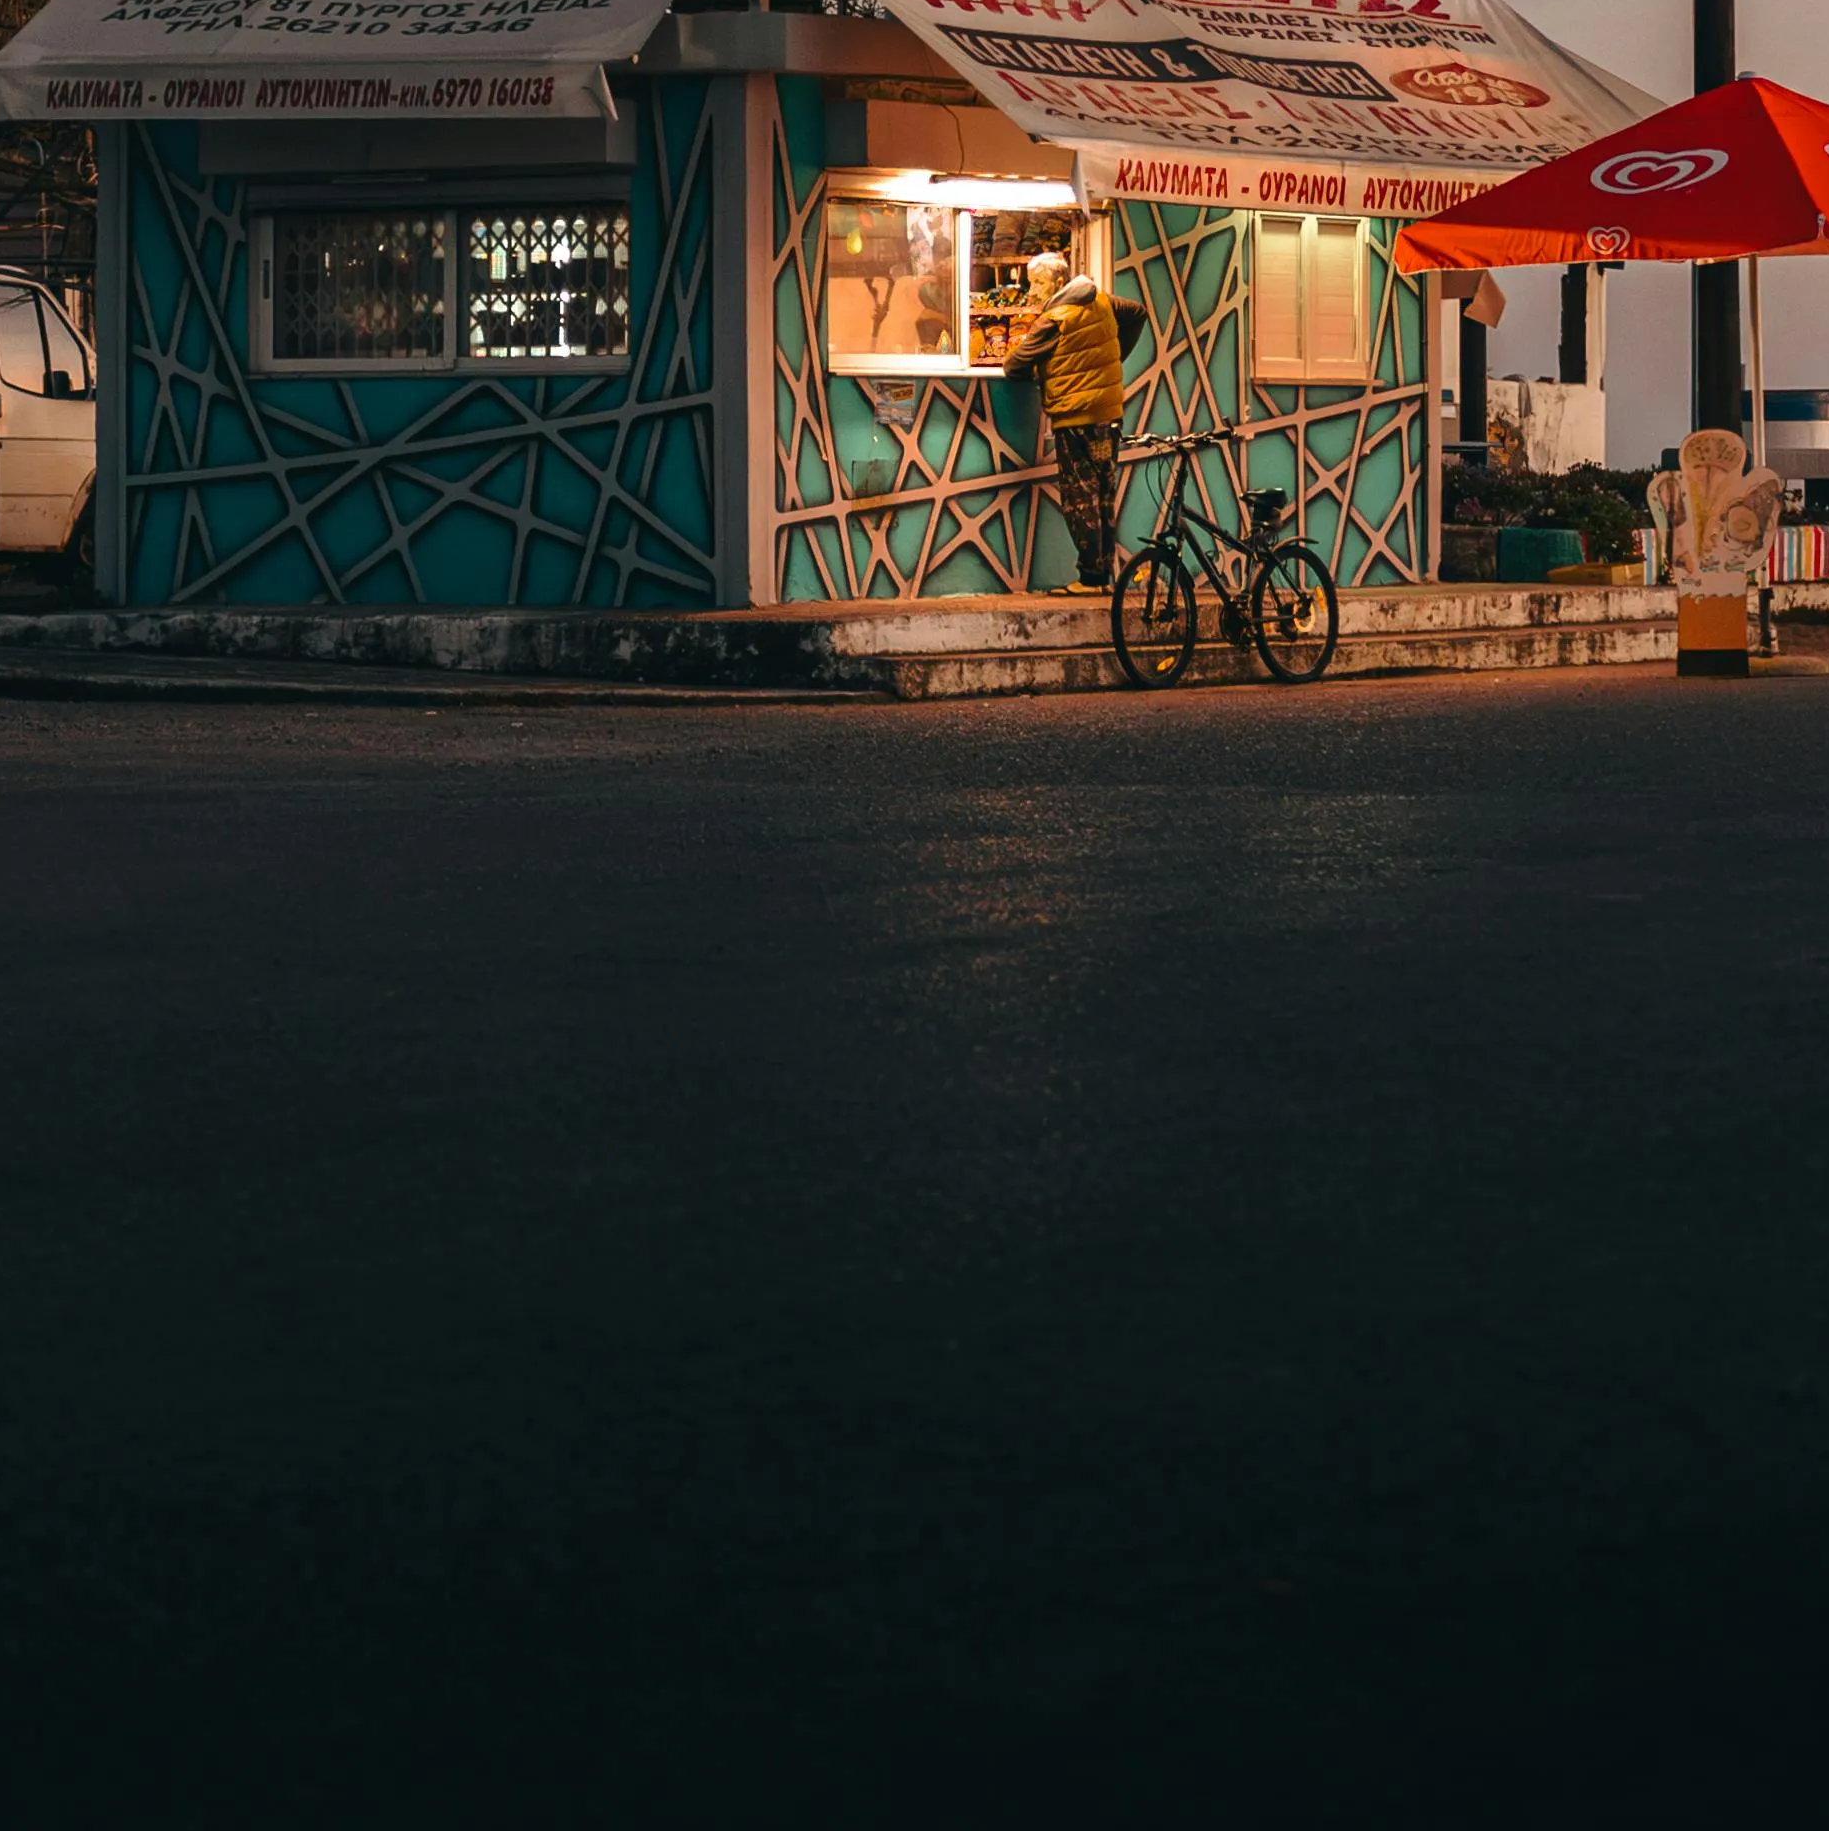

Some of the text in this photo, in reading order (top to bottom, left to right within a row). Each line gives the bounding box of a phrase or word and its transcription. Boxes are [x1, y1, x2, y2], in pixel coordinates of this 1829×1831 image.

[321, 1, 475, 18] ΠΥΡΓΟΣ
[401, 18, 535, 35] 34346
[1199, 22, 1342, 45] ΠΕΡΣΙΔΕΣ
[948, 32, 1382, 98] ΚΑΤΑΣΚΕΥΗ & ΤΟΠΟΘΕΤΗΣΗ
[47, 80, 143, 109] ΚΑΛΥΜΑΤΑ
[164, 79, 245, 108] ΟΥΡΑΝΟΙ
[1482, 143, 1572, 156] ΗΛΕΙ
[1115, 159, 1228, 199] ΚΑΛΥΜΑΤΑ
[1259, 171, 1347, 207] ΟΥΡΑΝΟΙ
[1363, 177, 1500, 213] ΑΥΤΟΚΙΝΗΤ
